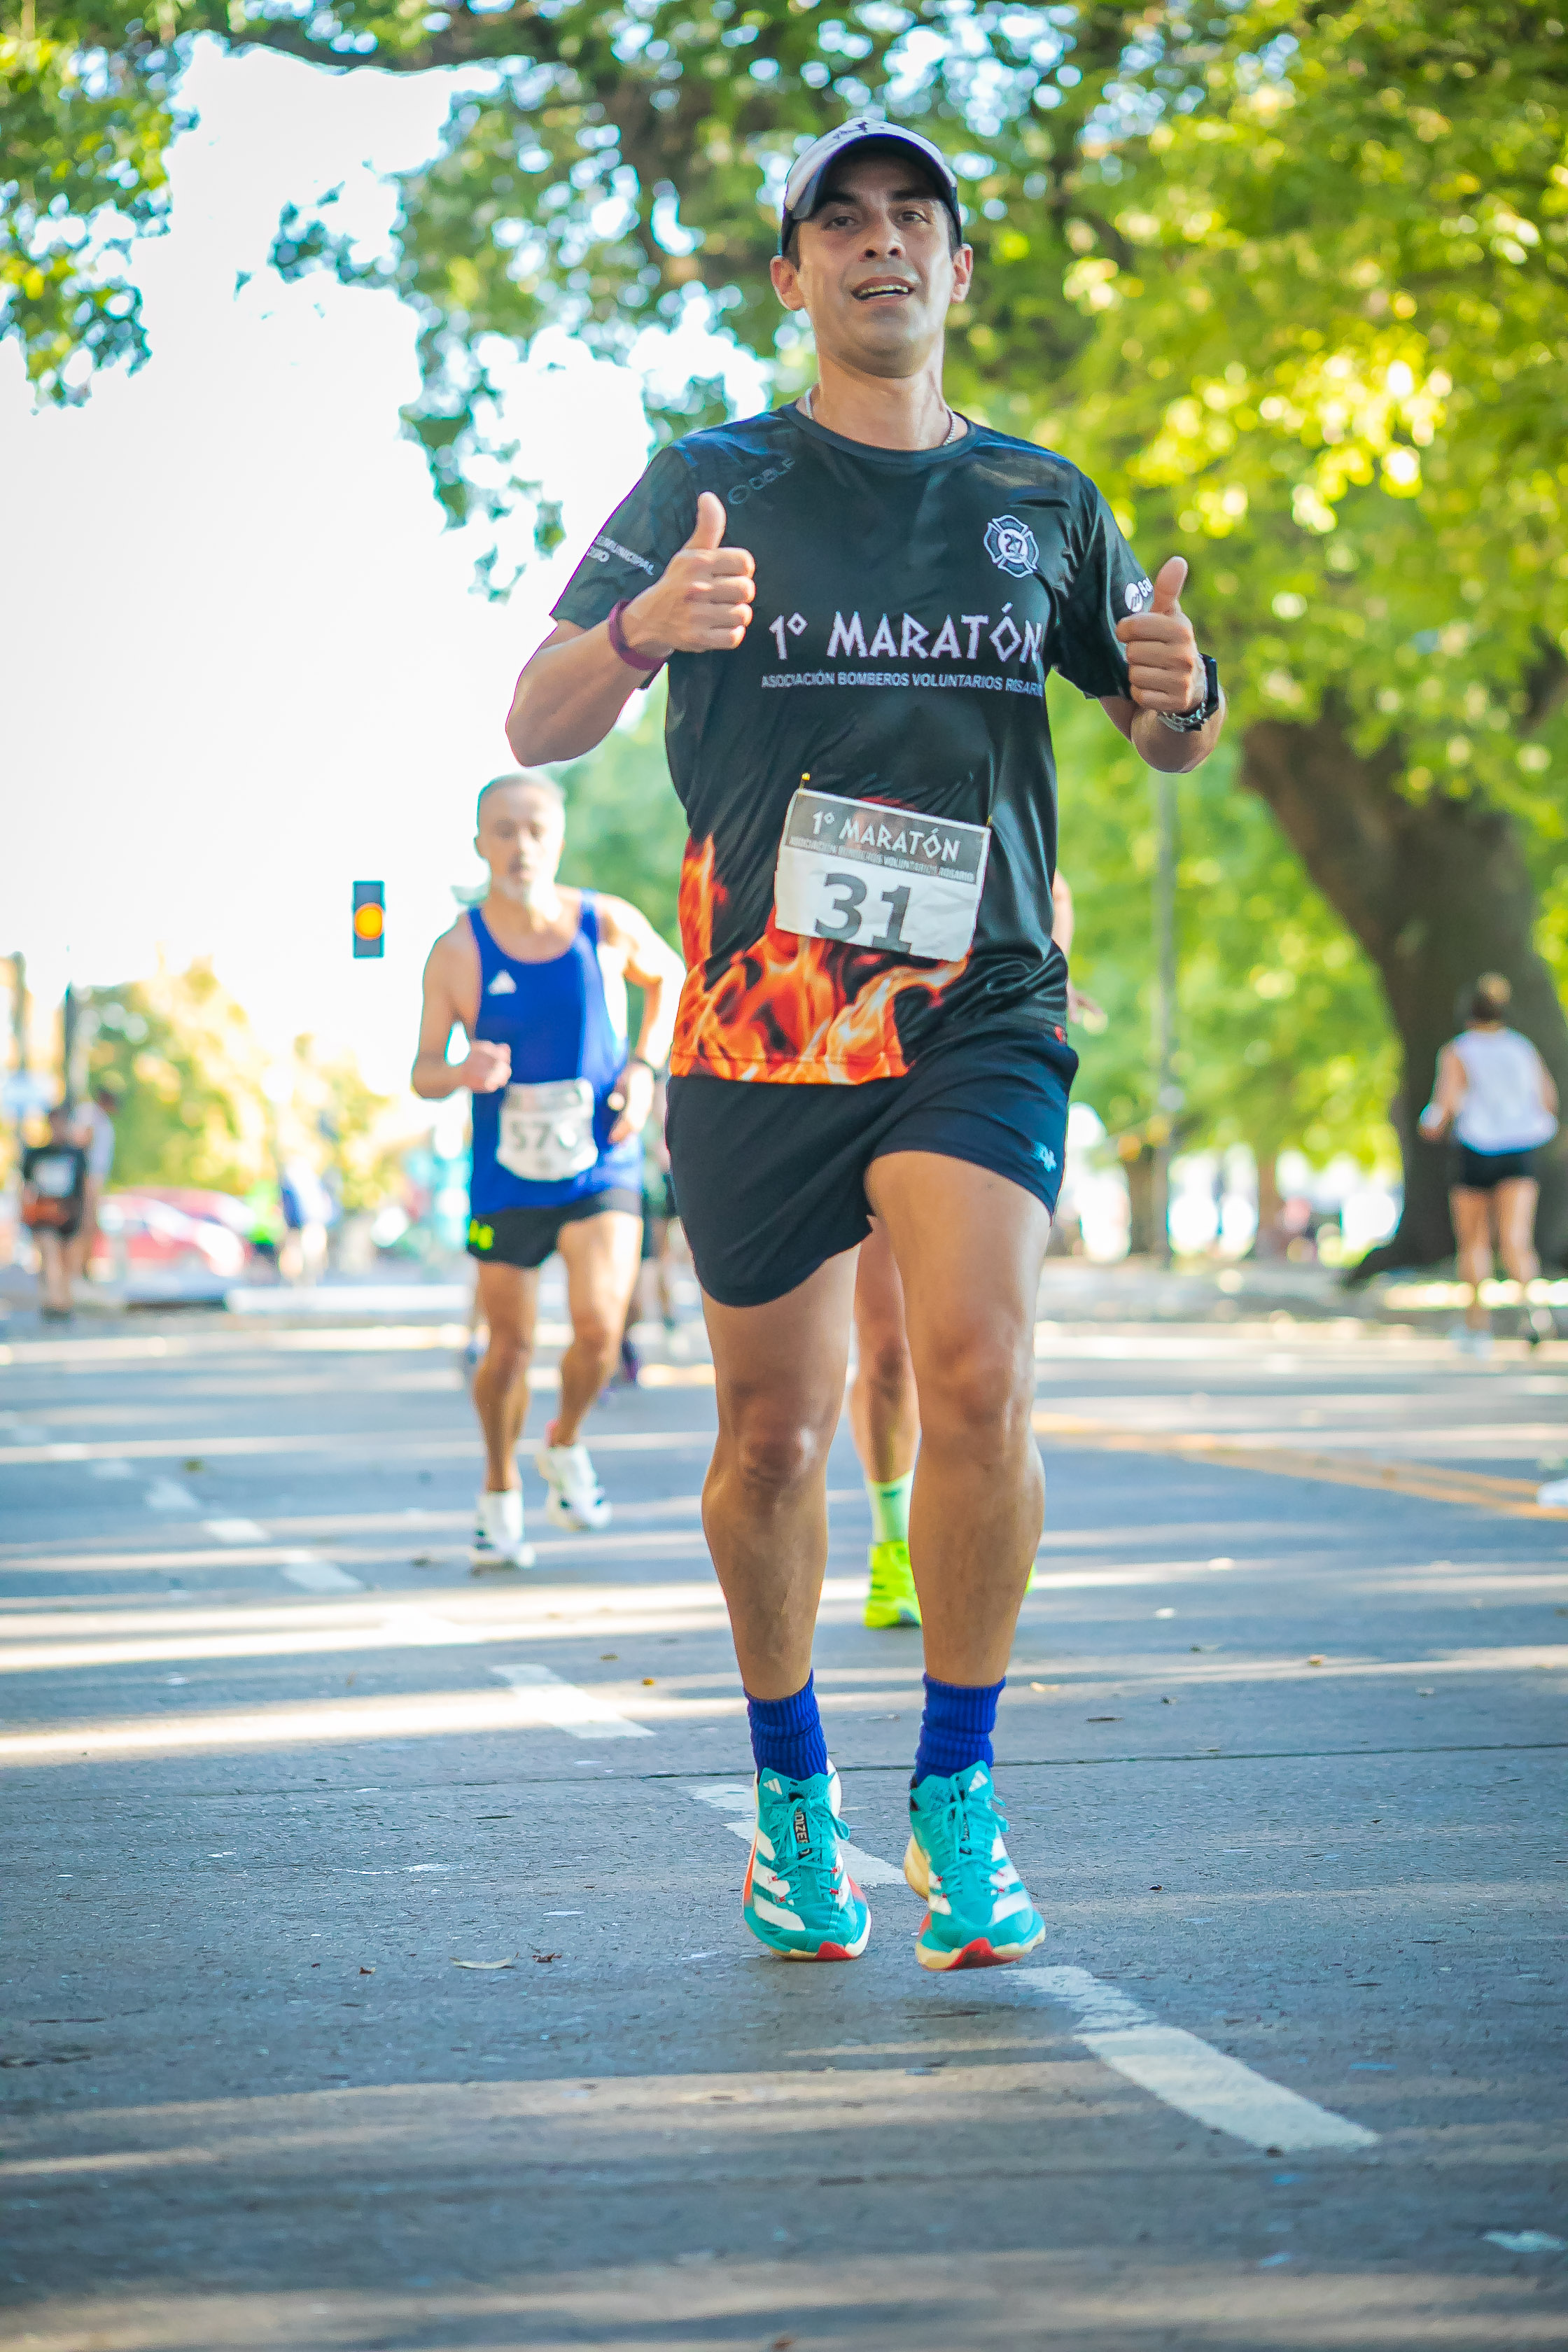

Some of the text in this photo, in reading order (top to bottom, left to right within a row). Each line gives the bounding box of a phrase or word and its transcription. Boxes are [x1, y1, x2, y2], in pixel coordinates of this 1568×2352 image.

[826, 601, 1043, 664] MARATÓN
[762, 669, 835, 687] ASOCIACIÓN
[838, 671, 910, 687] BOMBEROS
[911, 673, 1003, 691] VOLUNTARIOS
[839, 816, 961, 862] MARATÓN
[813, 872, 912, 954] 31
